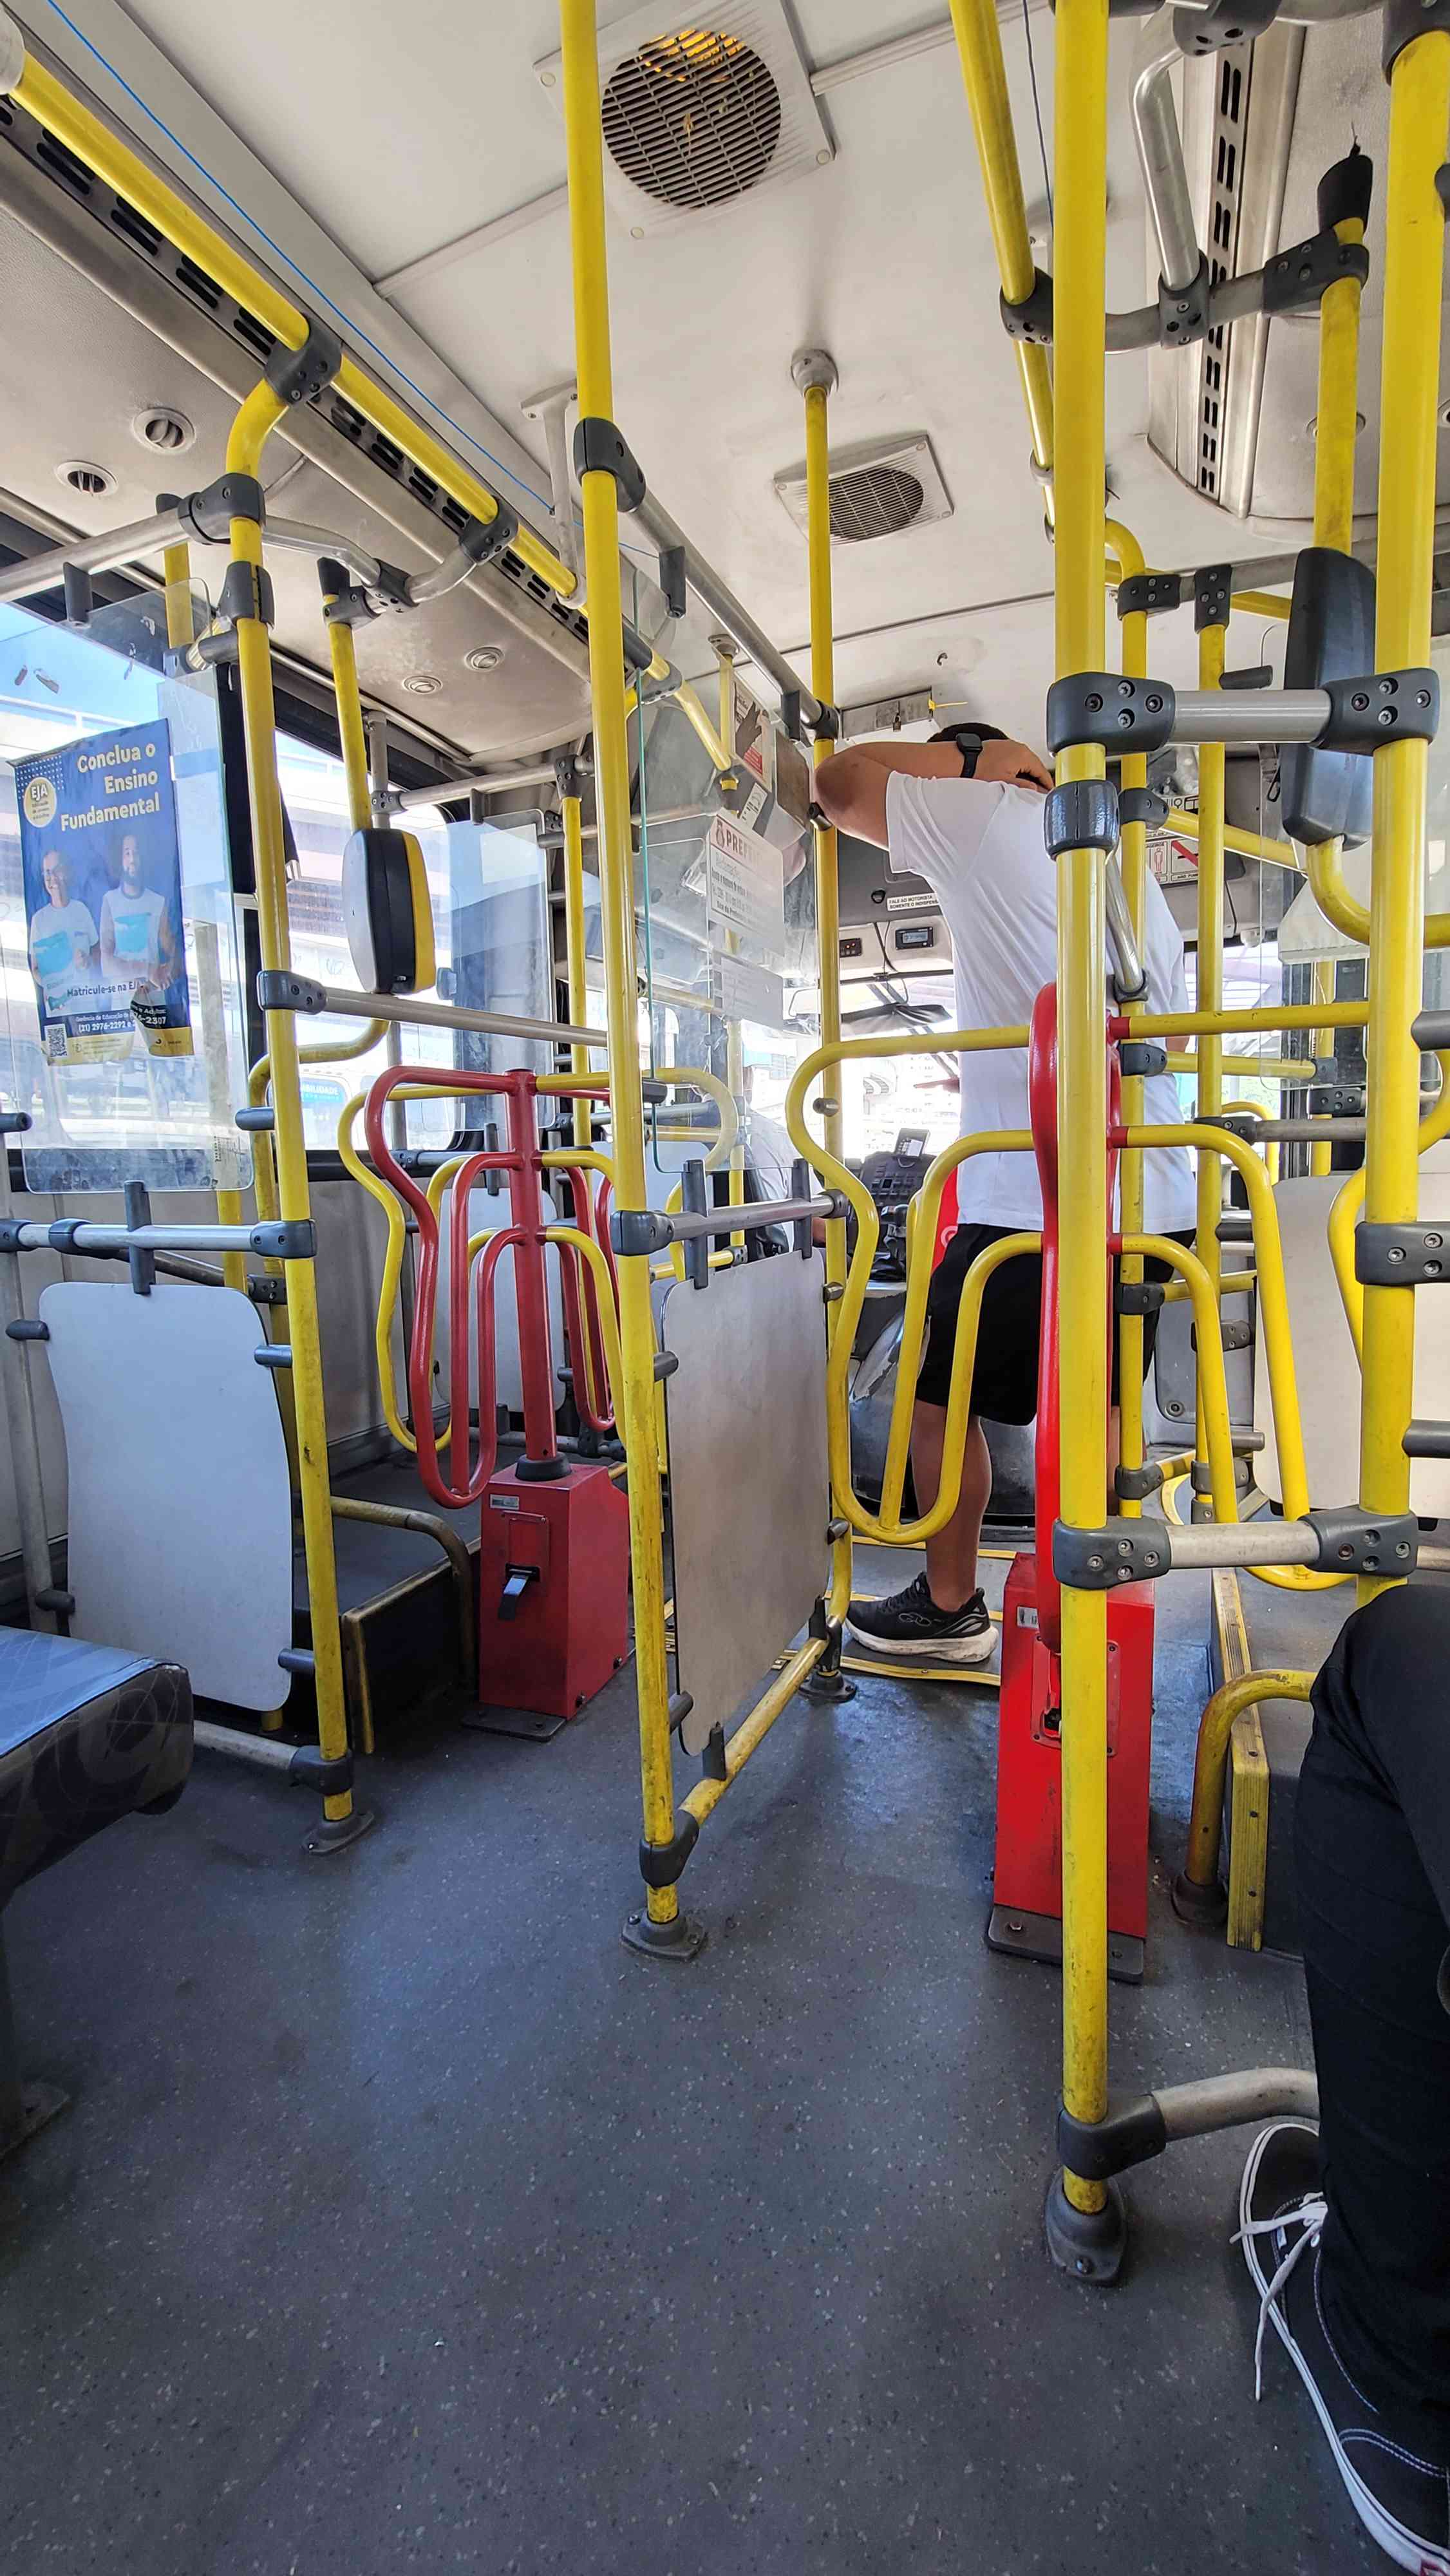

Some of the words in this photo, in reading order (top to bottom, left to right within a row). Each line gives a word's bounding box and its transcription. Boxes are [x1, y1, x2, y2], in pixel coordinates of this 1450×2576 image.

[77, 744, 141, 773] Conclua
[145, 743, 156, 757] o
[31, 784, 48, 801] EJA
[104, 768, 158, 794] Ensino
[61, 791, 160, 831] Fundamental
[67, 984, 117, 997] Matricule-se
